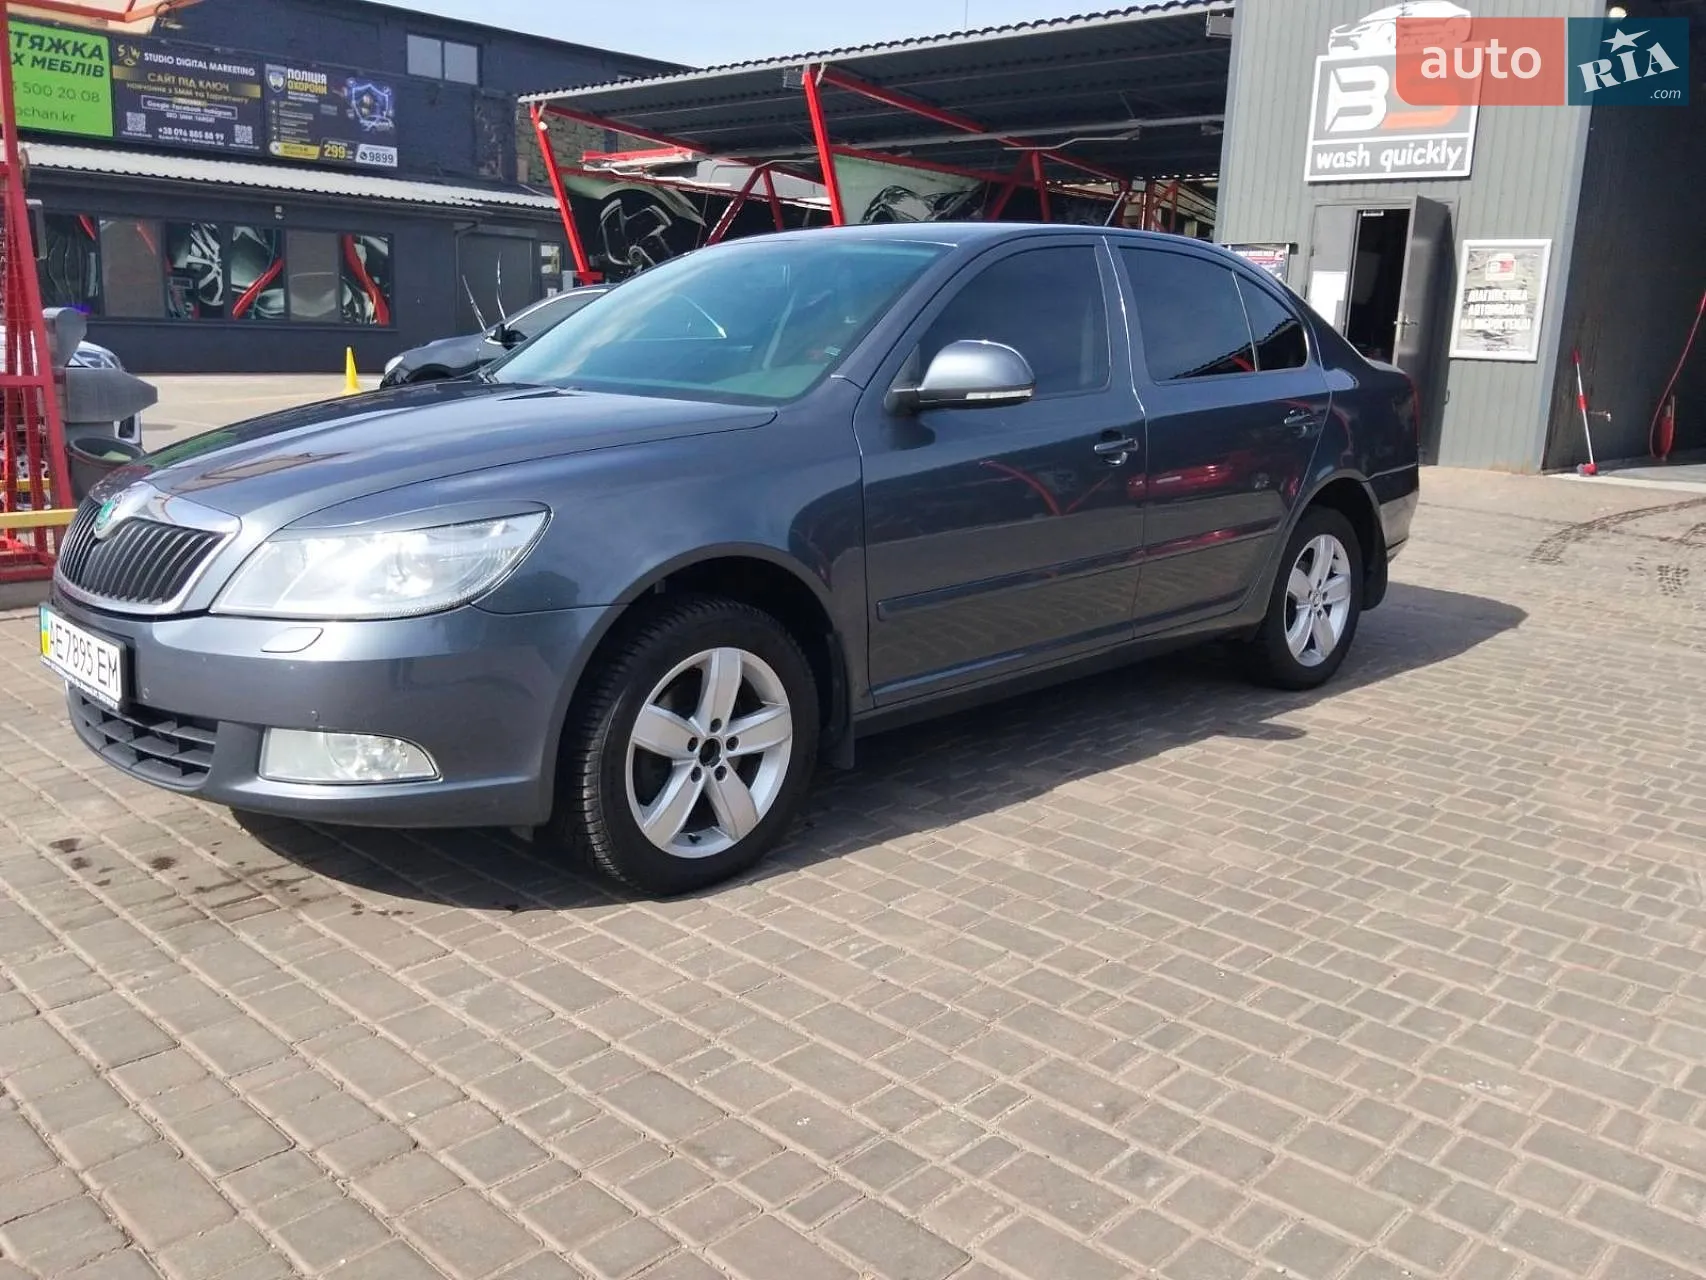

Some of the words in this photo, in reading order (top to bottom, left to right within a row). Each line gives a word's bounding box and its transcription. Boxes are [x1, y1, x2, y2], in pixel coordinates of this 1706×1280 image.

[9, 30, 104, 61] ТЯЖКА
[31, 55, 105, 78] МЕБЛІВ
[144, 52, 174, 65] STUDIO
[176, 57, 207, 70] DIGITAL
[209, 62, 255, 76] MARKETING
[287, 68, 327, 85] ПОЛІЦІЯ
[287, 80, 327, 95] ОХОРОНИ
[22, 80, 53, 98] 500
[57, 86, 77, 100] 20
[80, 90, 100, 103] 08
[323, 144, 346, 159] 299
[368, 151, 394, 163] 9899
[1315, 143, 1370, 170] wash
[1379, 140, 1463, 172] quickly
